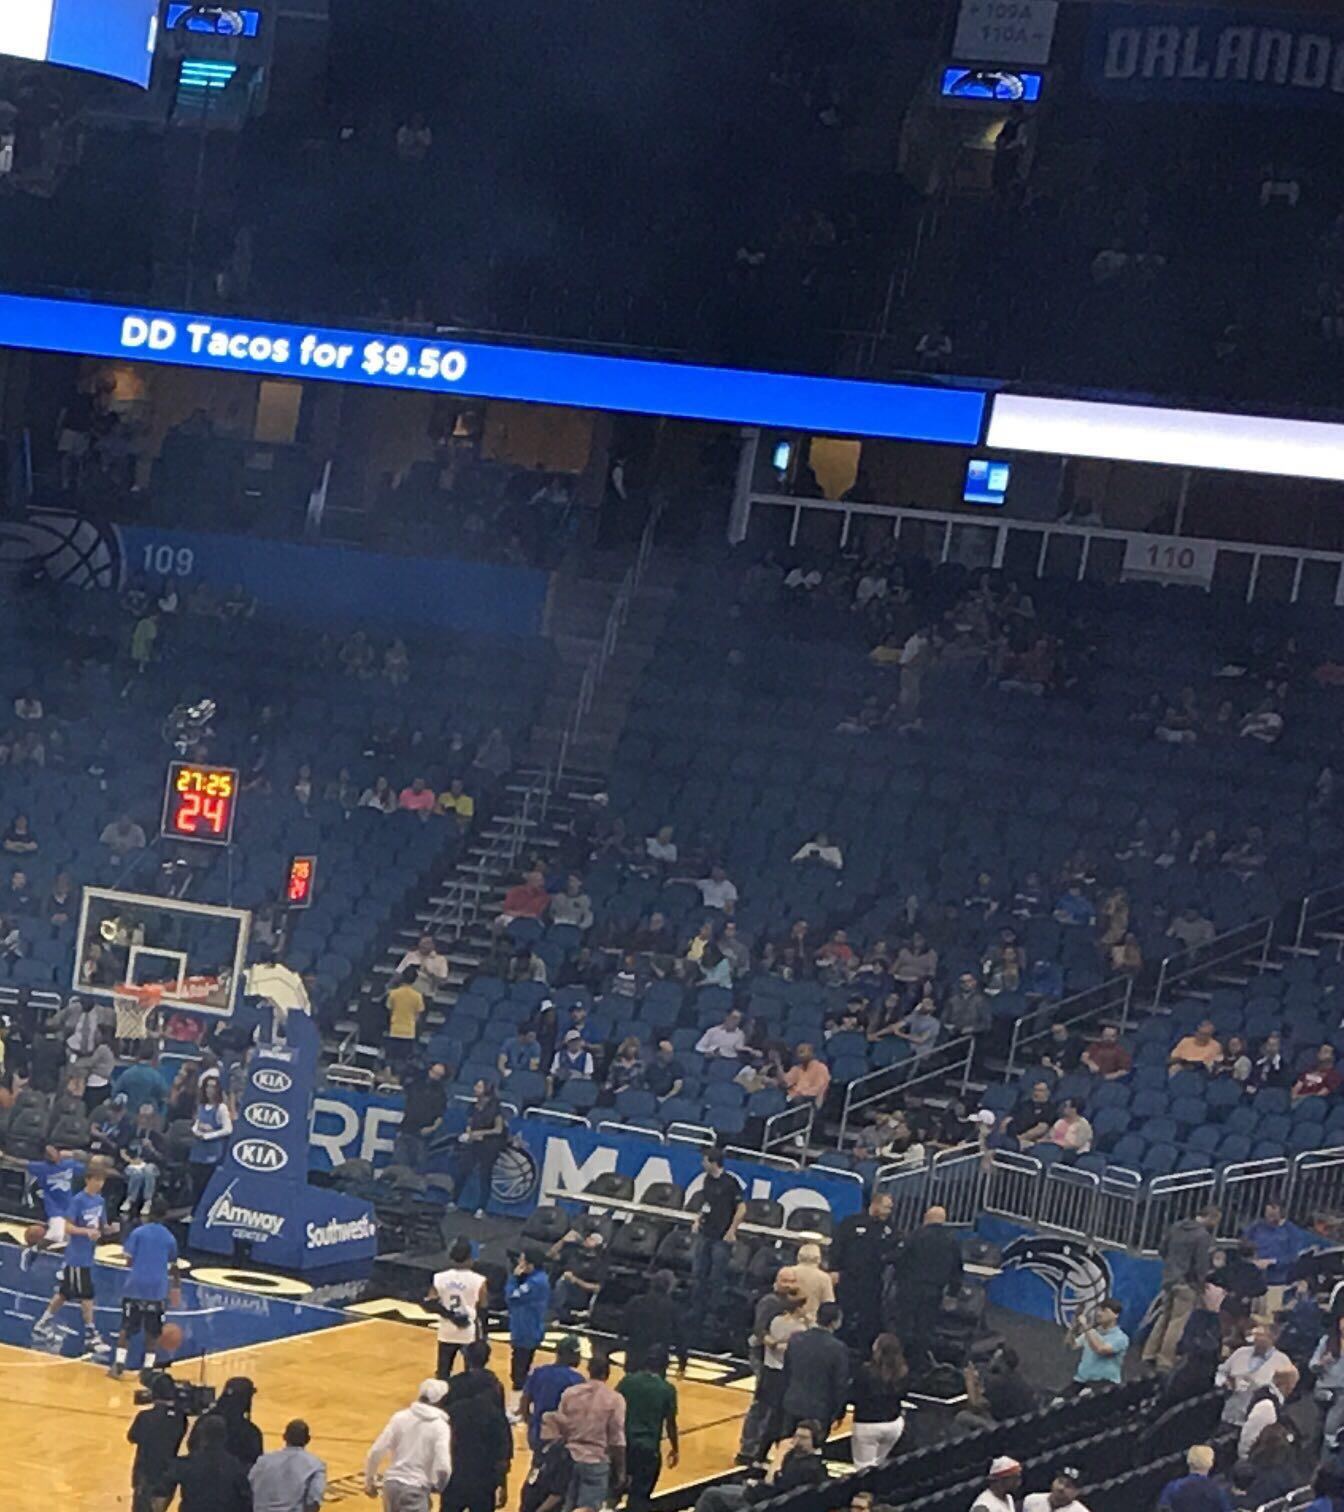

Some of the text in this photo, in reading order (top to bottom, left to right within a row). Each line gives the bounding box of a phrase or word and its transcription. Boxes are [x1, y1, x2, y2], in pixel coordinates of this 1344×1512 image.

[1104, 26, 1344, 92] ORLAND
[121, 316, 467, 381] DD Tacos for $9.50
[143, 544, 194, 576] 109
[1147, 544, 1196, 569] 110
[176, 770, 231, 797] 27:25
[177, 794, 224, 832] 24
[215, 1197, 286, 1237] Amway
[307, 1214, 370, 1248] Southwest
